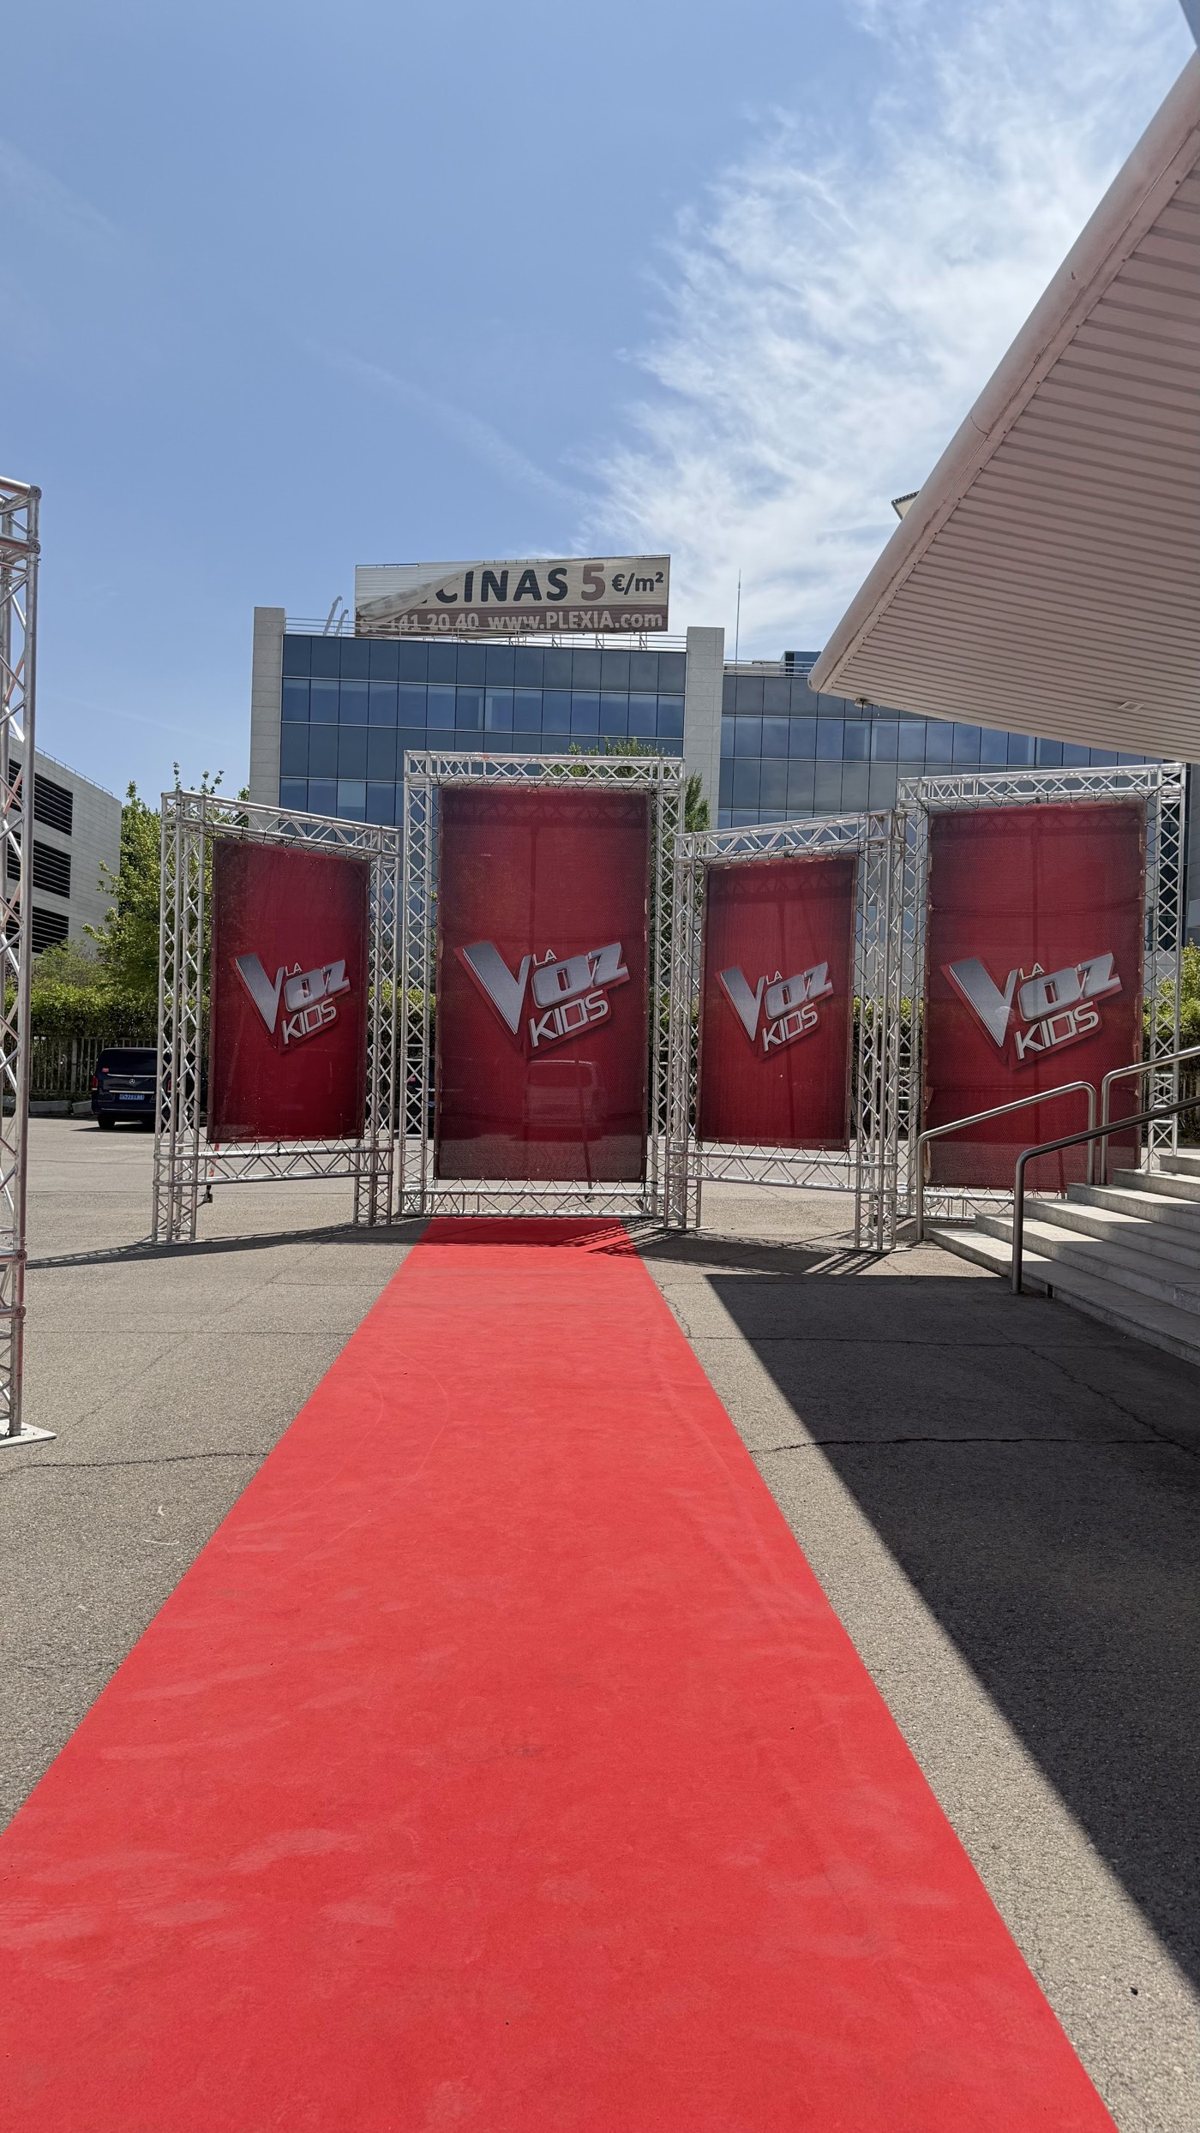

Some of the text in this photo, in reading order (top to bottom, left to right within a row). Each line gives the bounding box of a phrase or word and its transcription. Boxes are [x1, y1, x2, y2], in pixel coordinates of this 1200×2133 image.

[580, 563, 606, 602] 5
[487, 610, 663, 630] www.PLEXIA.com
[284, 962, 303, 976] LA
[533, 948, 558, 967] LA
[1019, 963, 1046, 980] LA
[766, 970, 784, 985] LA
[282, 997, 337, 1045] KIDS
[529, 989, 609, 1048] KIDS
[762, 1003, 819, 1052] KIDS
[1014, 1001, 1100, 1060] KIDS
